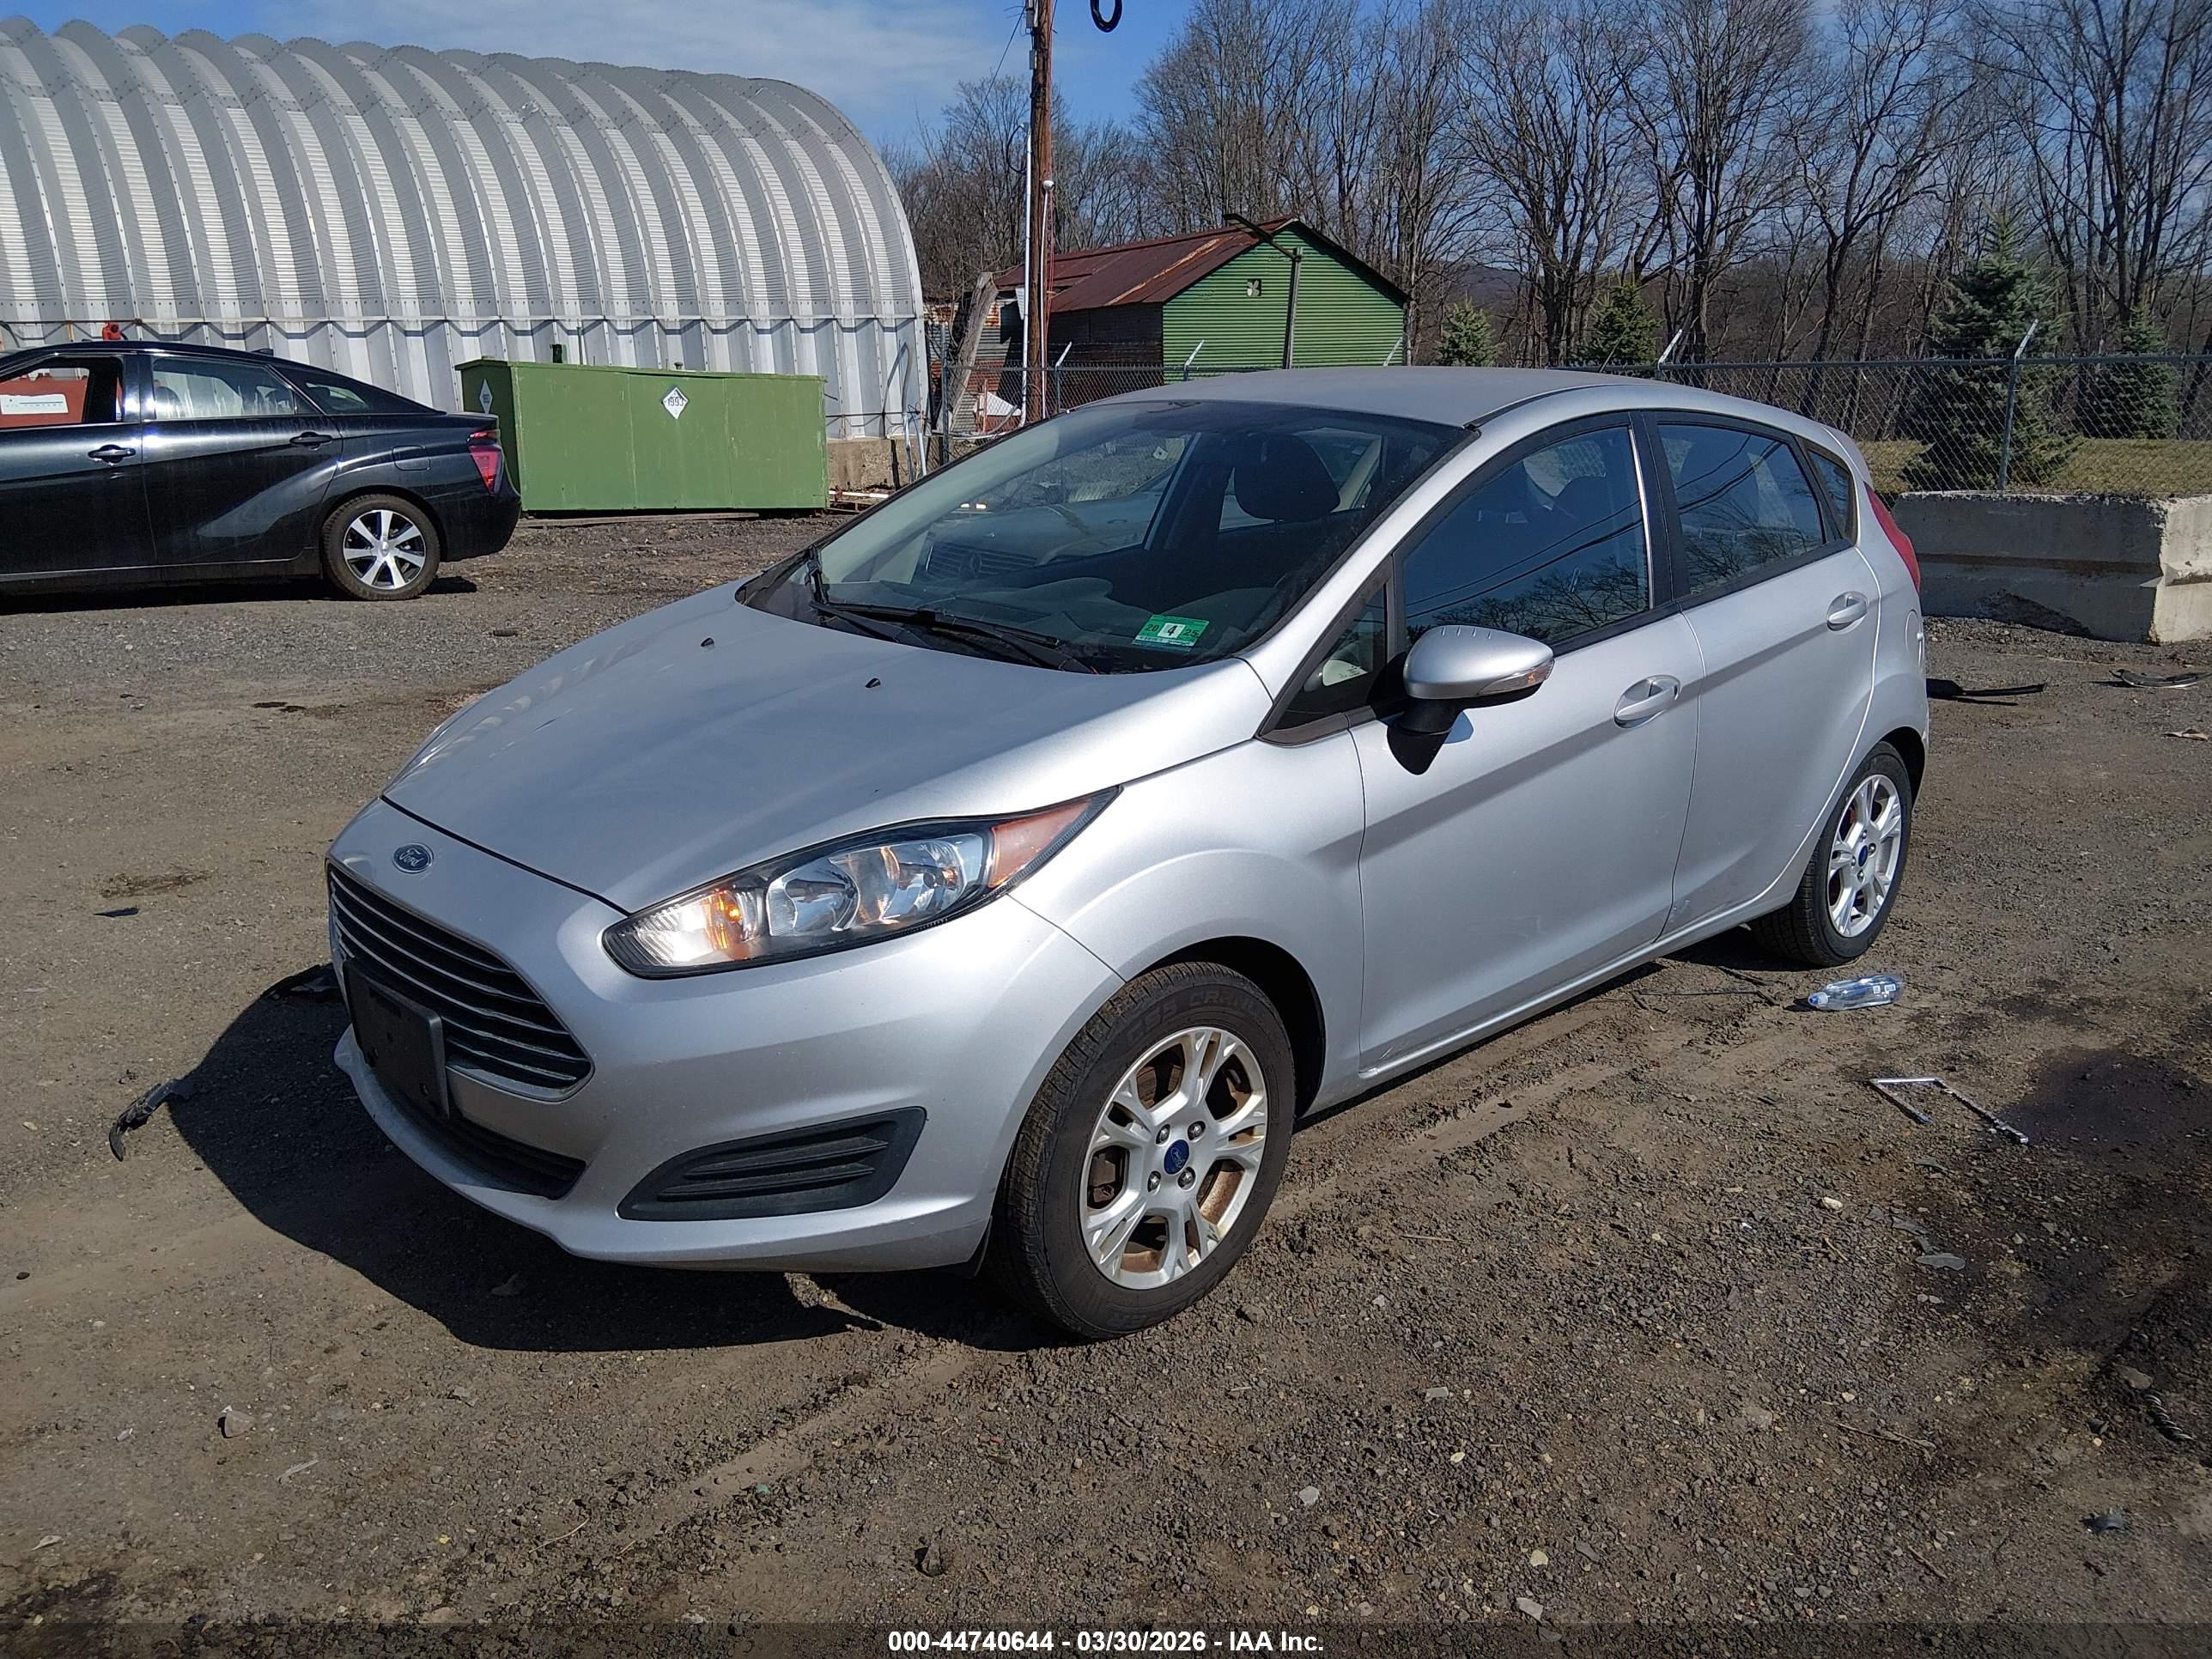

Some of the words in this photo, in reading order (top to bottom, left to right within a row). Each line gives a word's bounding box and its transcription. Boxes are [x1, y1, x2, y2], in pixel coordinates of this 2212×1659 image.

[1145, 623, 1159, 632] 20
[1167, 624, 1176, 636] 4
[1182, 629, 1199, 638] 25
[399, 848, 424, 867] Ford
